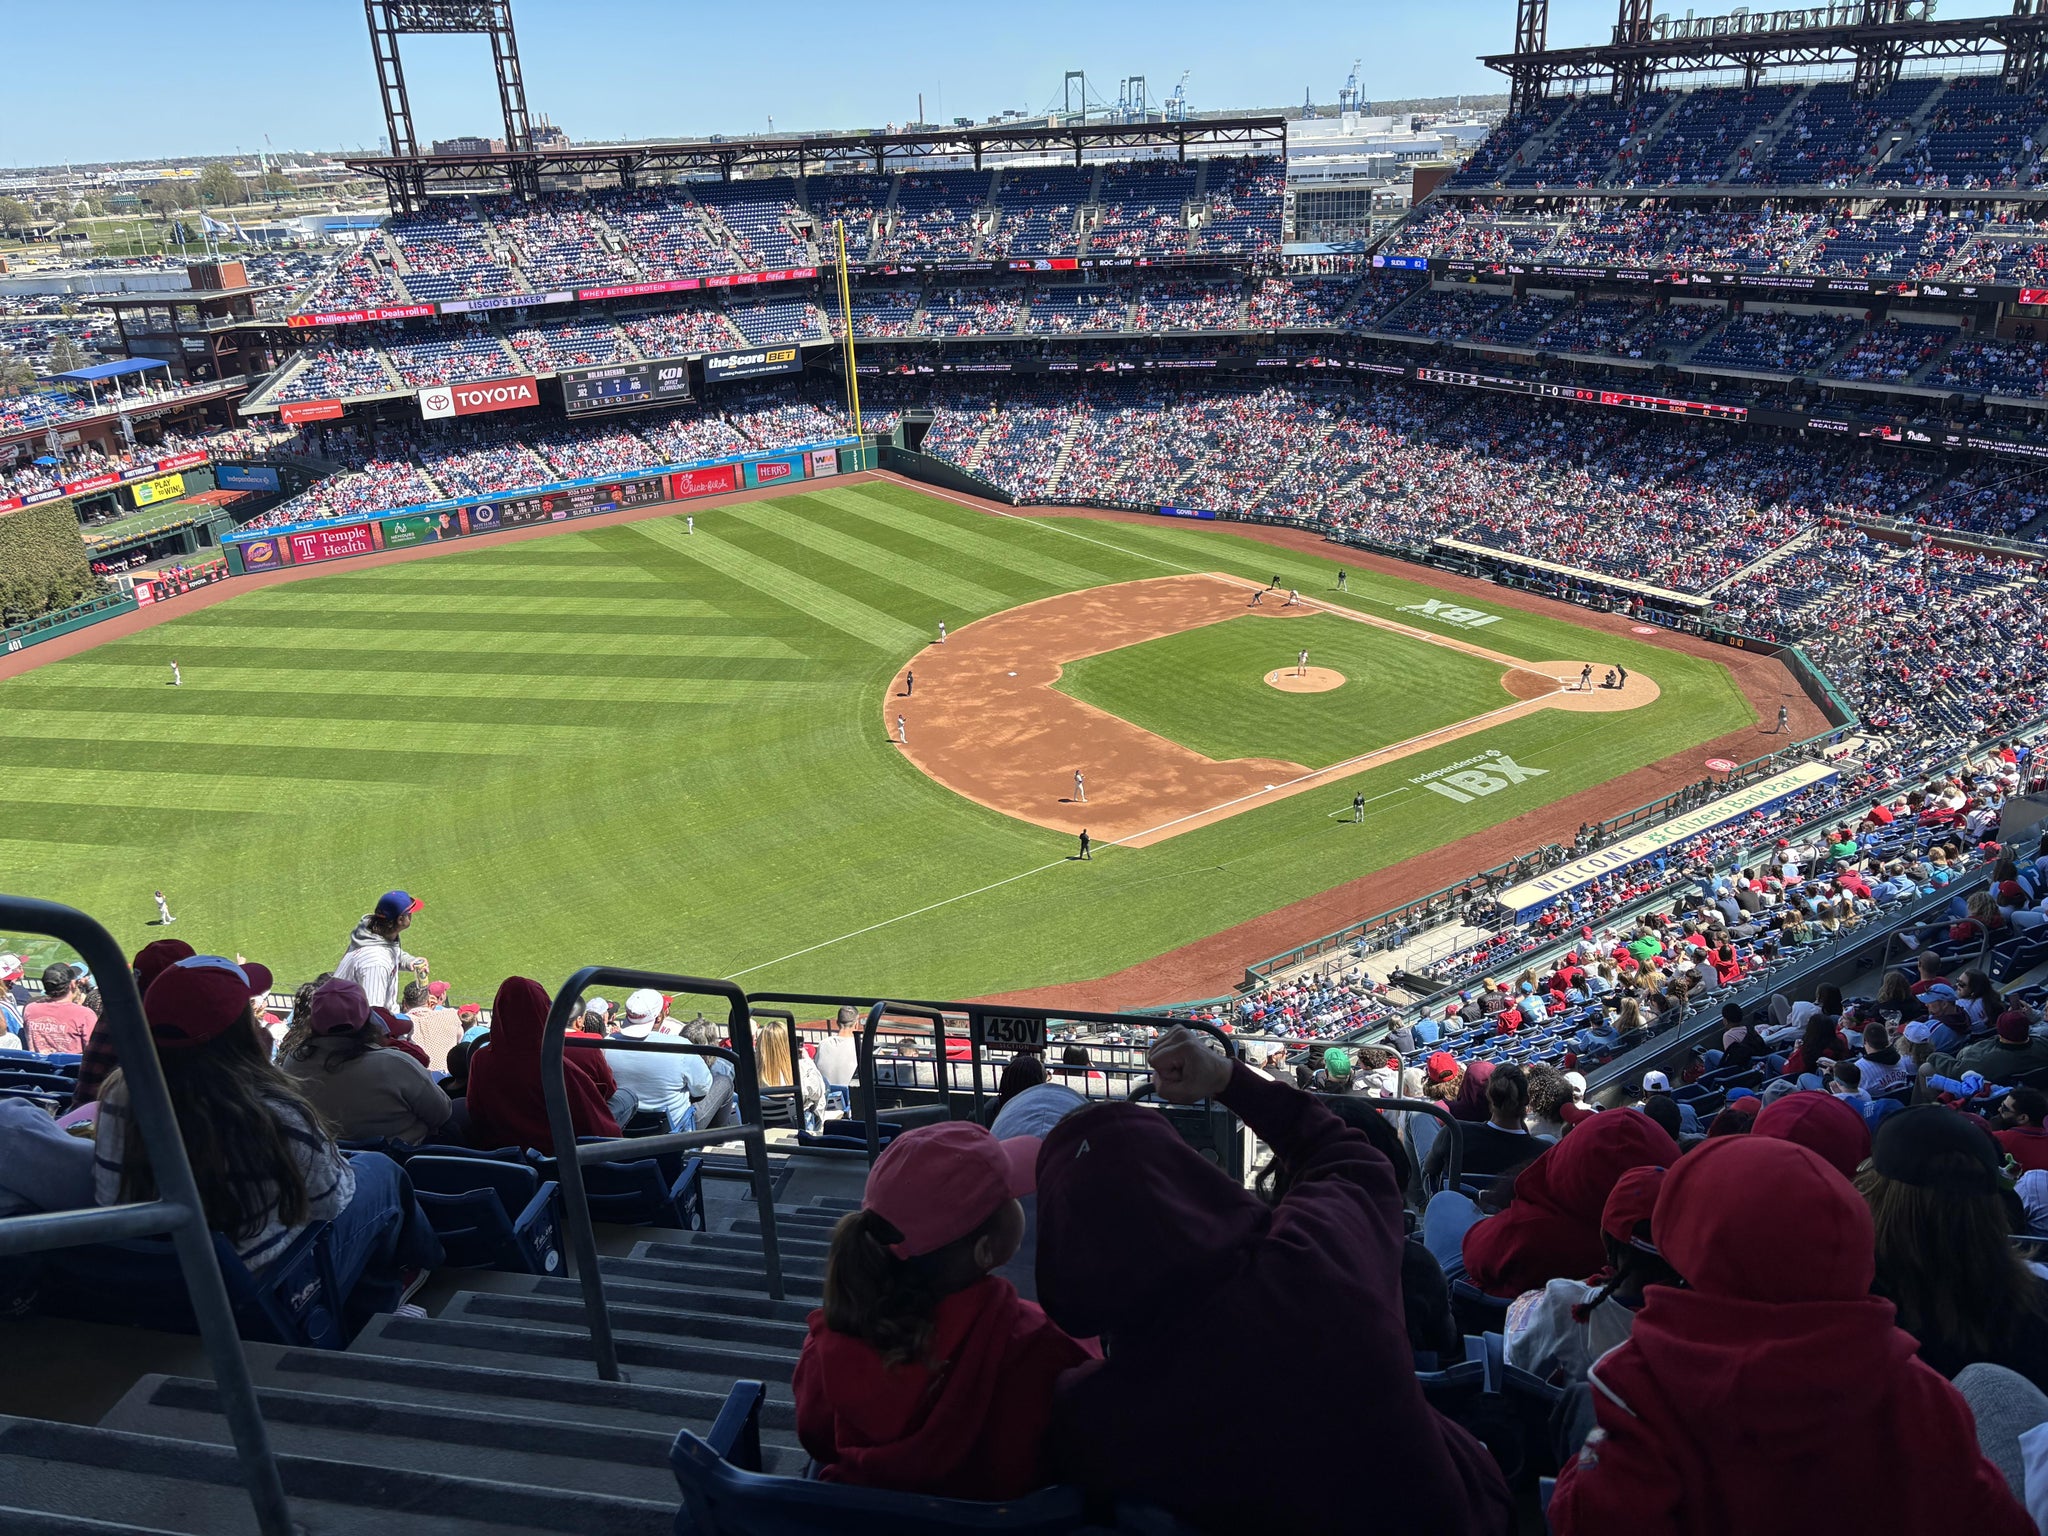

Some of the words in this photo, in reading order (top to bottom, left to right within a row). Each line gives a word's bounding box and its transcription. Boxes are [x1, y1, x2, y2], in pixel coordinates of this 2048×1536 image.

[582, 290, 605, 298] WHEY
[607, 287, 633, 295] BETTER
[635, 284, 666, 293] PROTEIN
[1923, 285, 1948, 296] Phillies
[468, 298, 508, 310] LISCIO'S
[511, 295, 547, 305] BAKERY
[382, 310, 404, 318] Deals
[406, 308, 419, 316] roll
[315, 314, 346, 324] Phillies
[709, 354, 765, 369] theScore
[769, 351, 793, 361] BET
[587, 370, 604, 379] NOLAN
[659, 383, 685, 392] TECHNOLOGY
[1540, 385, 1559, 396] 1-0
[457, 384, 532, 407] TOYOTA
[1808, 422, 1848, 431] ESCALADE
[1907, 431, 1931, 442] Phillies
[174, 455, 200, 466] Budweiser
[815, 455, 834, 463] WM
[760, 465, 787, 476] HERR'S
[82, 477, 113, 489] Budweiser
[154, 479, 171, 490] PLAY
[164, 485, 180, 496] WIN!
[320, 528, 366, 543] Temple
[324, 541, 366, 556] Health
[189, 579, 207, 588] TOYOTA
[1405, 598, 1504, 626] IBX
[8, 640, 22, 652] 401
[1408, 752, 1487, 784] Independence
[1424, 755, 1550, 803] IBX
[1532, 846, 1638, 892] WELCOME
[1664, 806, 1726, 838] Citizens
[1726, 788, 1768, 818] Bank
[1768, 773, 1807, 798] Park
[987, 1018, 1040, 1043] 430V
[1879, 1071, 1906, 1088] MARSH
